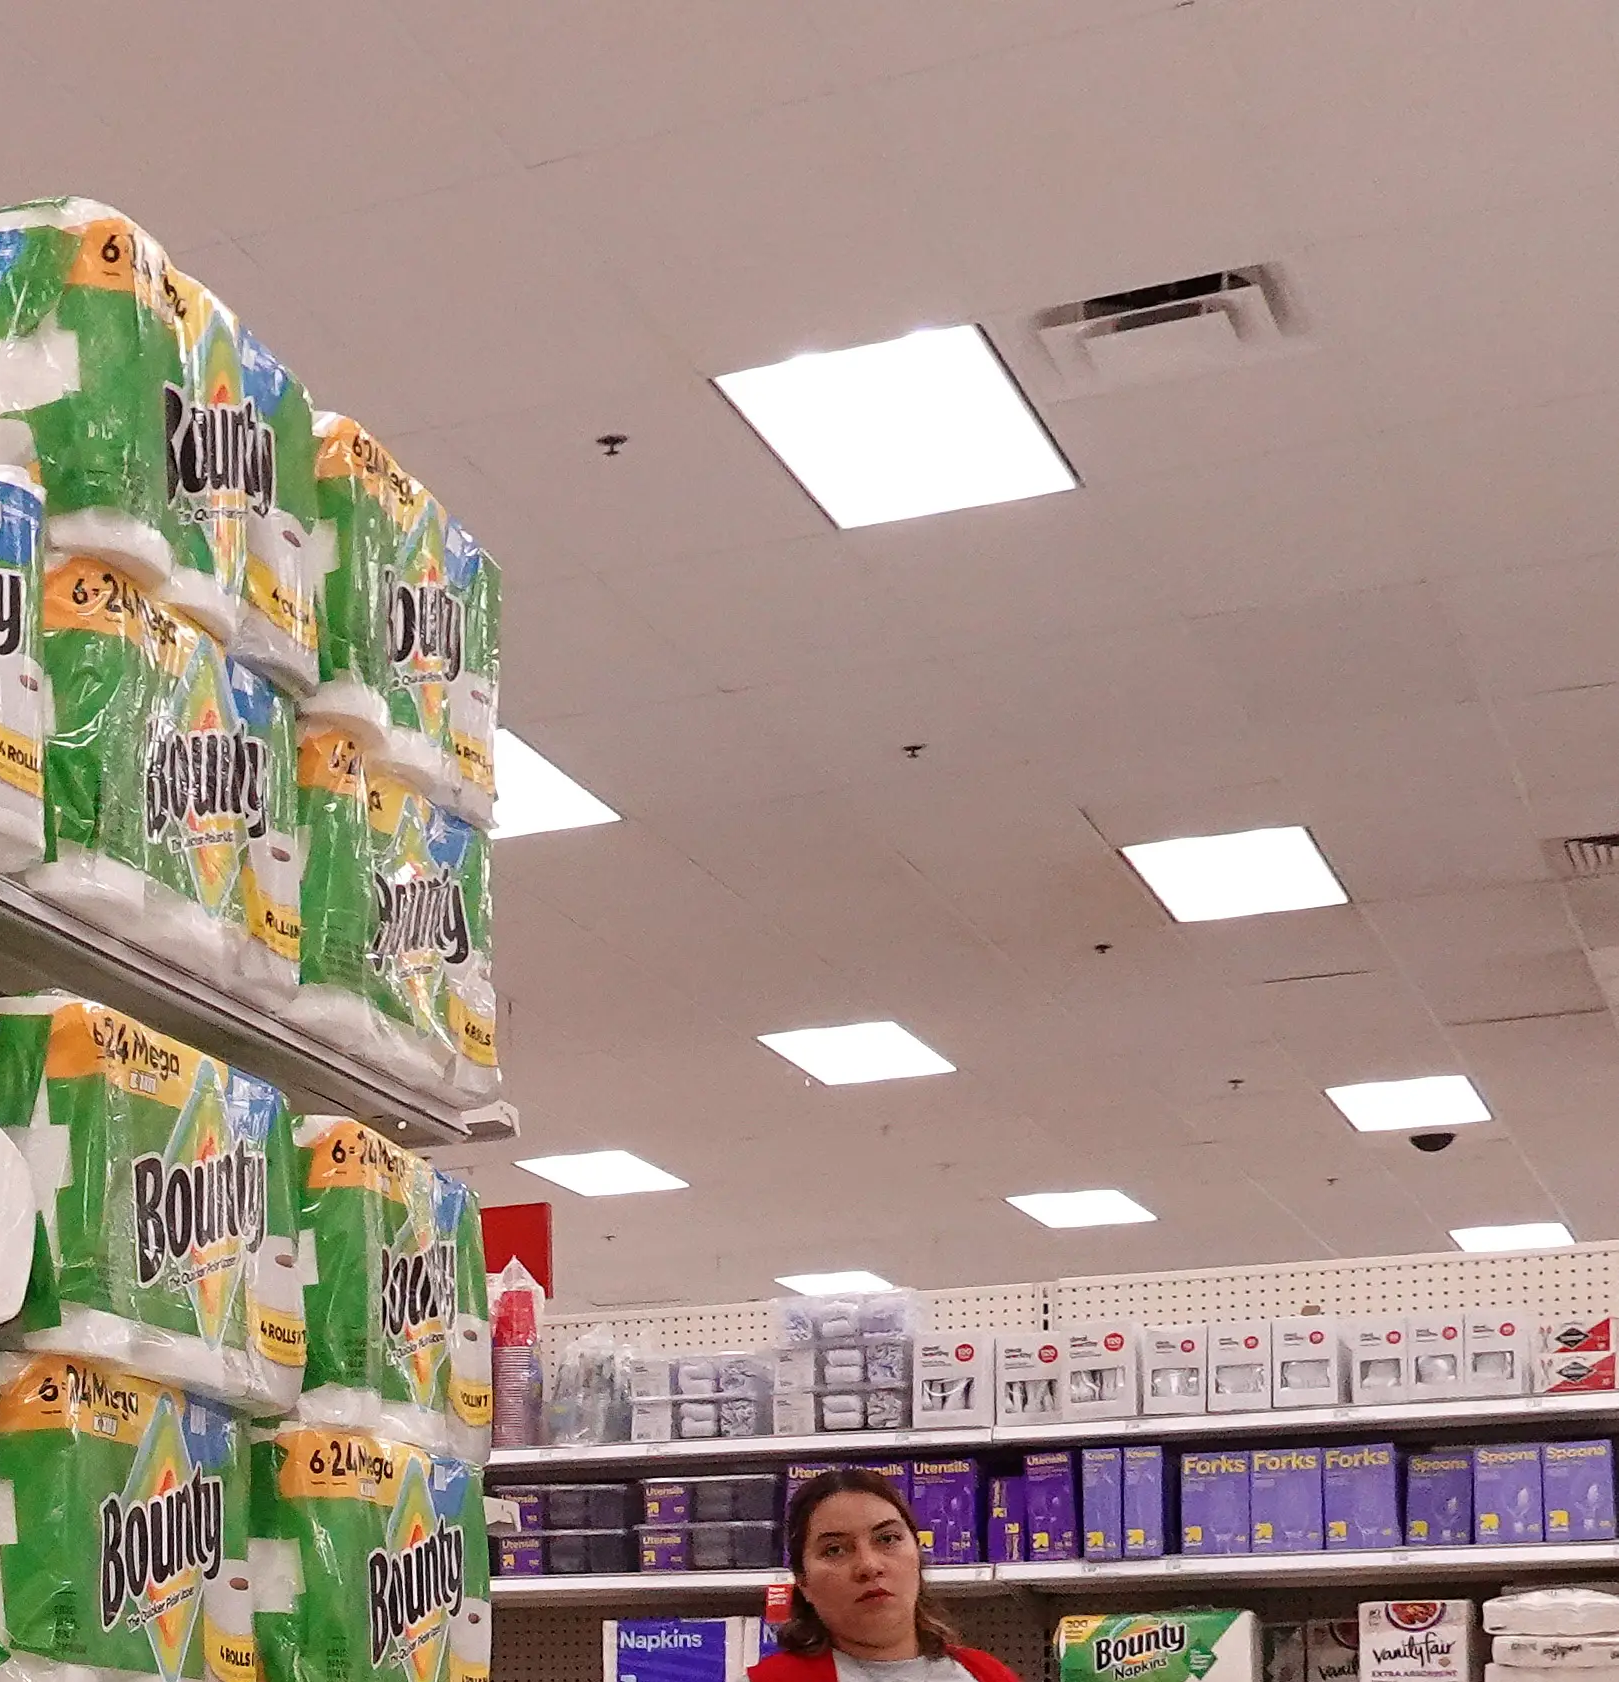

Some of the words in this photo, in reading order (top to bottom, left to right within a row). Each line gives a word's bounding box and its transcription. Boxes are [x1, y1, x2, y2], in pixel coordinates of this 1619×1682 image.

[133, 1030, 181, 1080] Mega
[137, 1139, 265, 1286] Bounty
[1253, 1451, 1317, 1470] Forks
[1326, 1448, 1389, 1467] Forks
[1477, 1449, 1536, 1465] Spoons
[1546, 1445, 1606, 1461] Spoons
[913, 1461, 970, 1474] Utensils
[1184, 1455, 1245, 1474] Forks
[1412, 1457, 1469, 1473] Spoons
[103, 1464, 223, 1629] Bounty
[643, 1535, 682, 1545] Utensils
[370, 1521, 462, 1668] Bounty
[619, 1630, 703, 1652] Napkins
[1095, 1622, 1186, 1672] Bounty
[1113, 1657, 1167, 1682] Napkins
